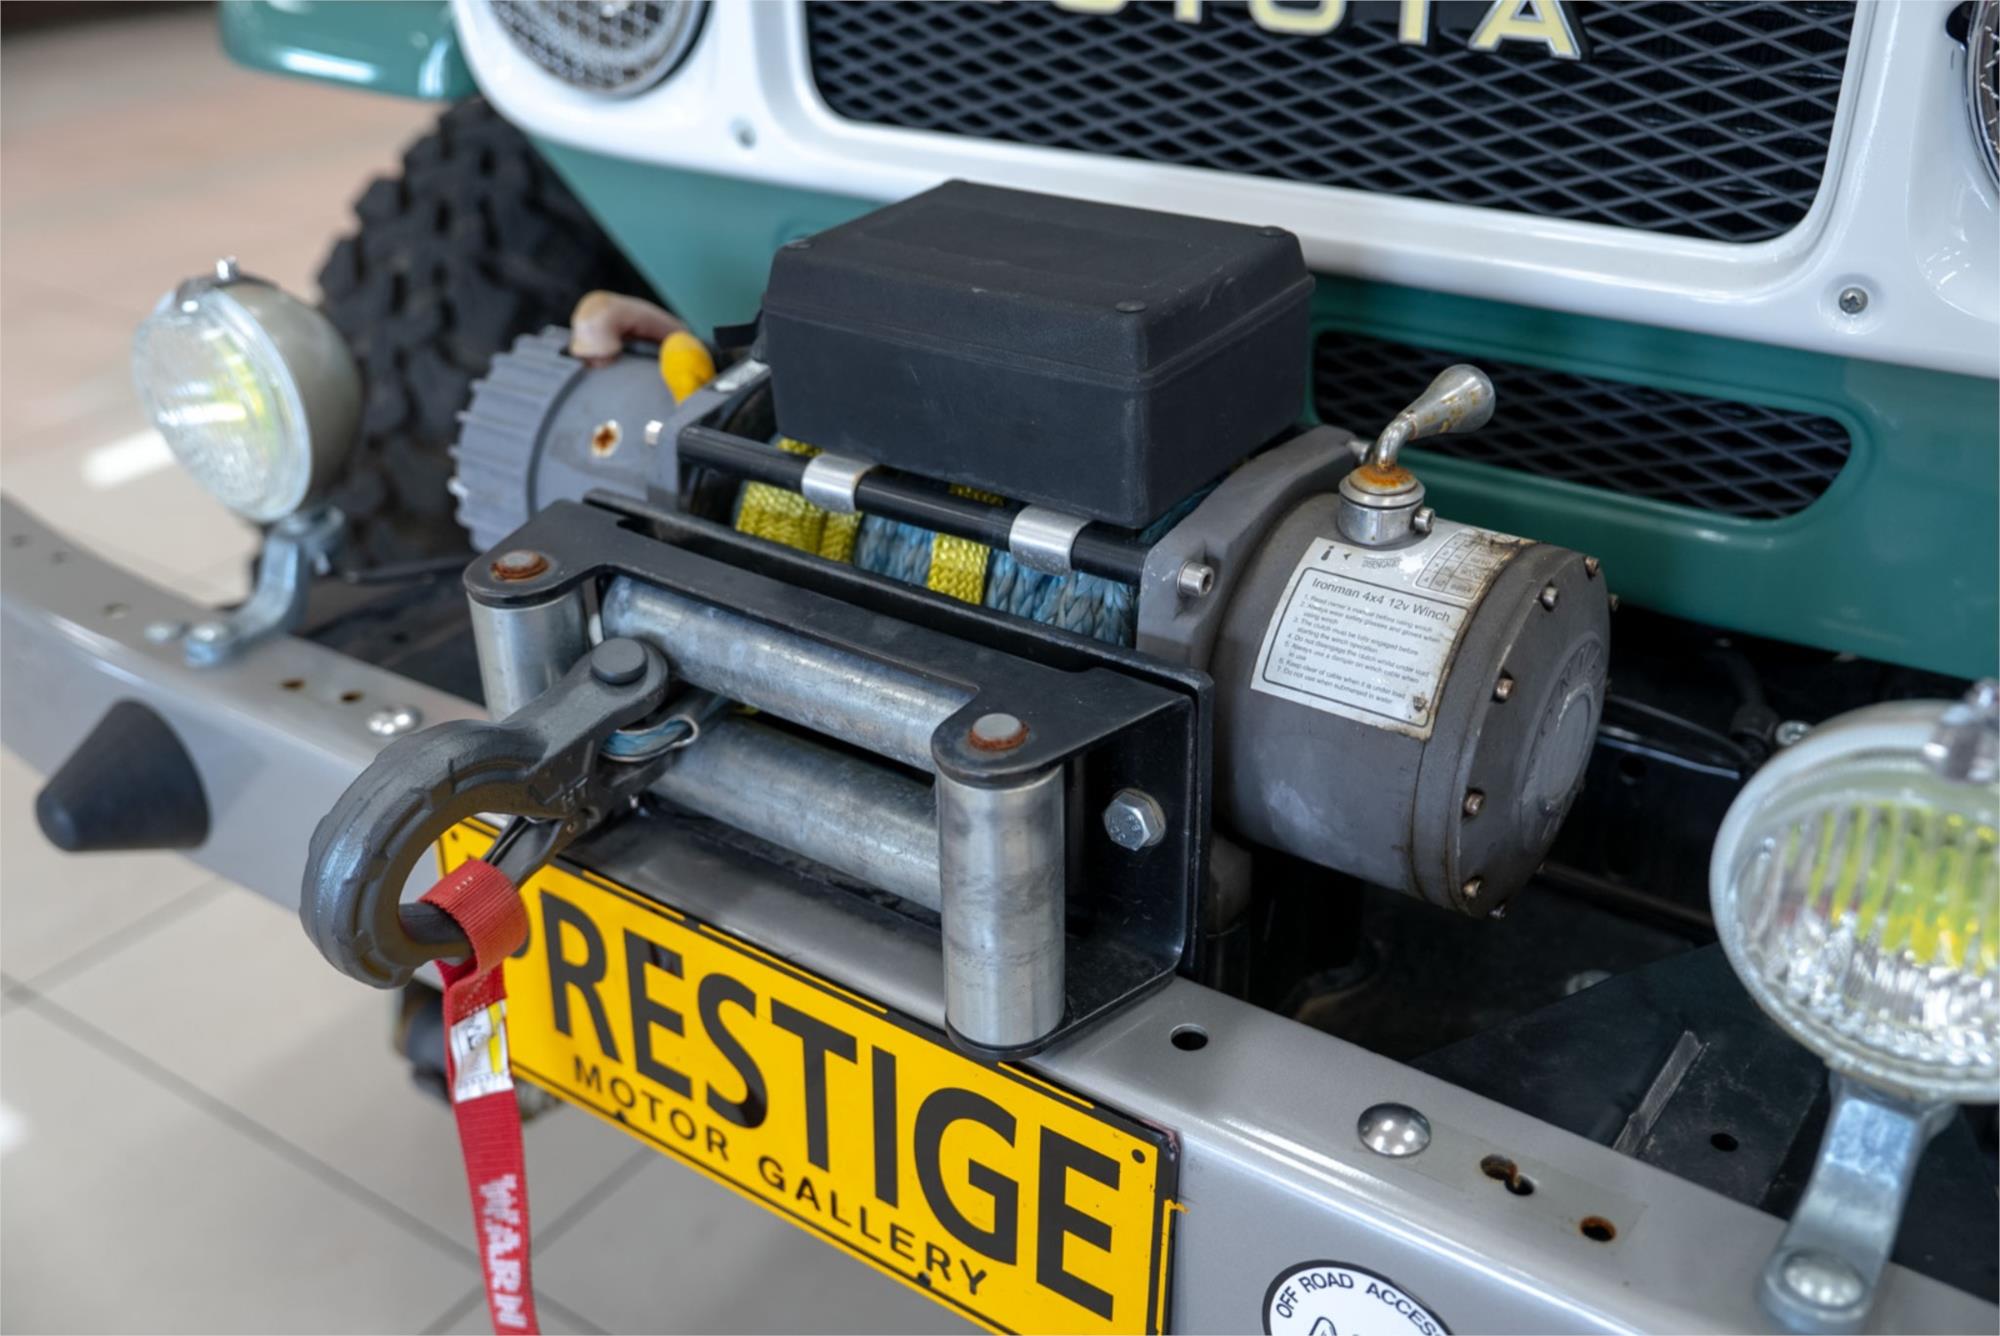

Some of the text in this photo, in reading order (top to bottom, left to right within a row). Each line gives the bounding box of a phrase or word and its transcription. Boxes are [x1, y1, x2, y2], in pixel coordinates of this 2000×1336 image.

[1311, 577, 1451, 623] Ironman 4x4 12v Winch
[1286, 660, 1302, 669] Keep
[1302, 665, 1318, 673] clear
[1371, 638, 1398, 650] engaged
[1398, 646, 1419, 655] before
[1317, 678, 1333, 686] when
[511, 888, 1122, 1321] RESTIGE
[572, 1053, 988, 1297] MOTOR GALLERY
[479, 1173, 528, 1329] WARN
[1275, 1272, 1442, 1336] OFF ROAD ACCES
